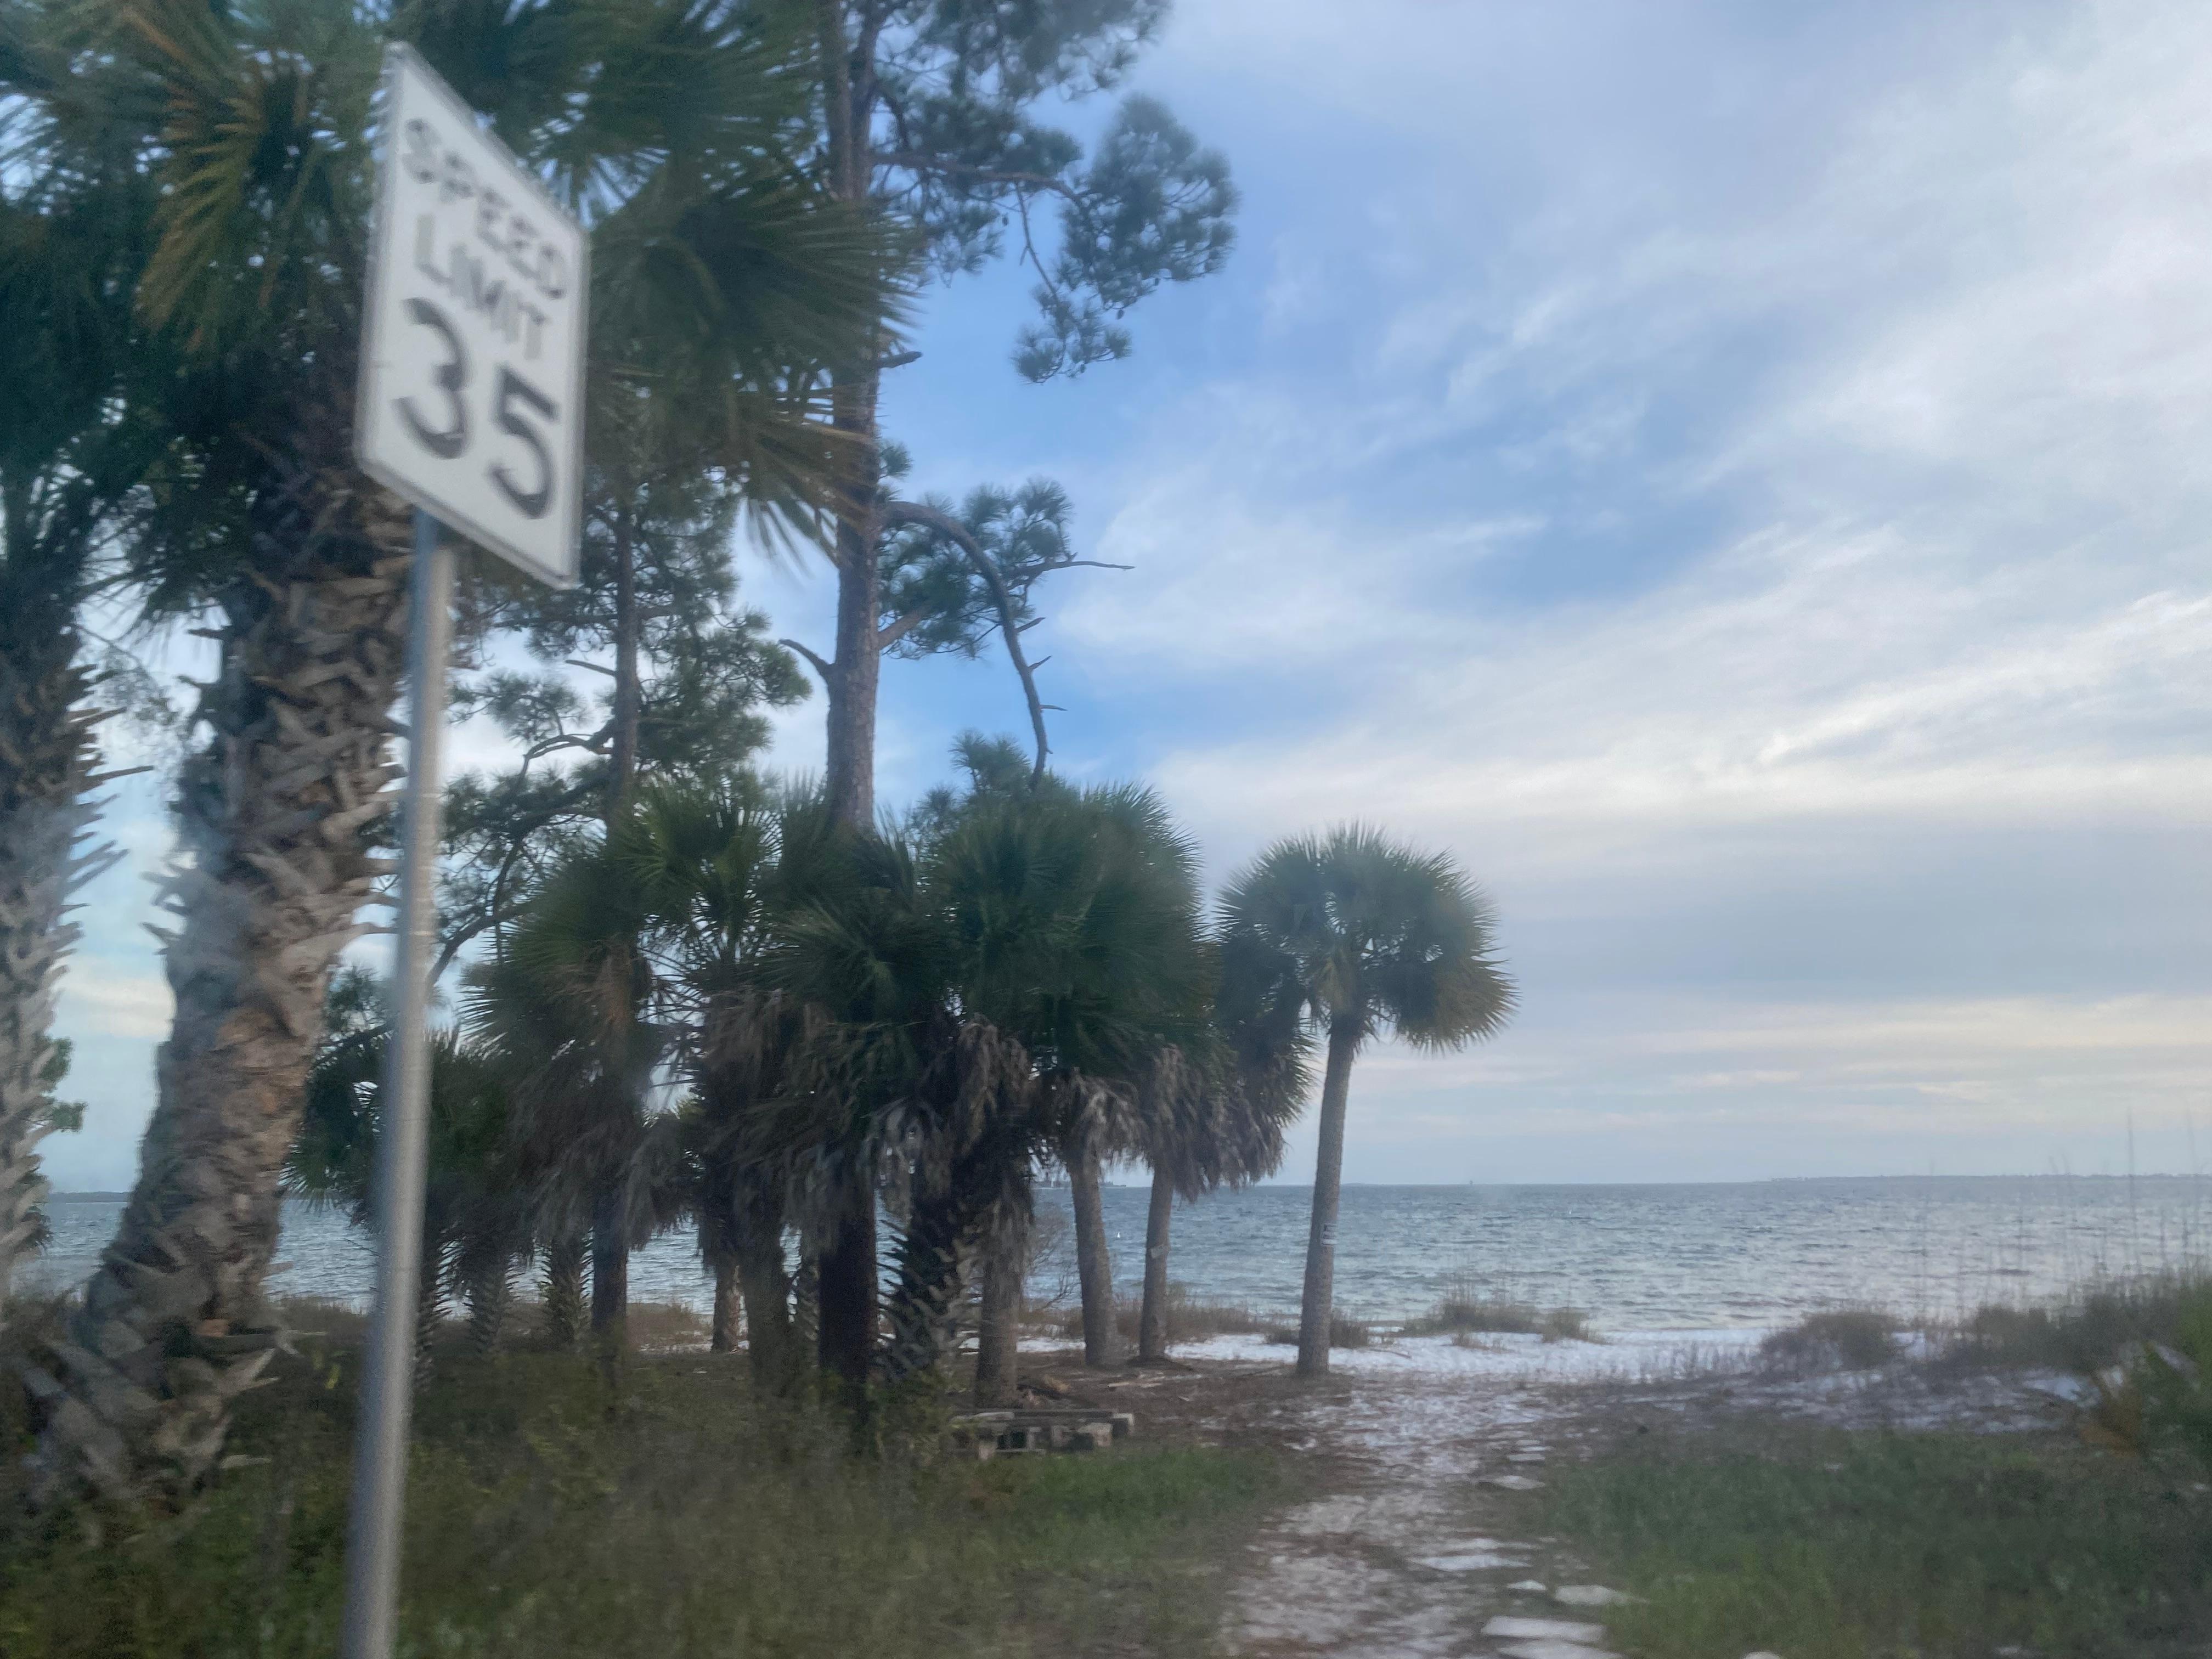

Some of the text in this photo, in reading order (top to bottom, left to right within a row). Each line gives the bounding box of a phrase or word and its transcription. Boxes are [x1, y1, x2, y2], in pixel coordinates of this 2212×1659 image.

[403, 117, 568, 300] SPEED
[415, 213, 549, 360] LIMIT
[391, 296, 560, 520] 35
